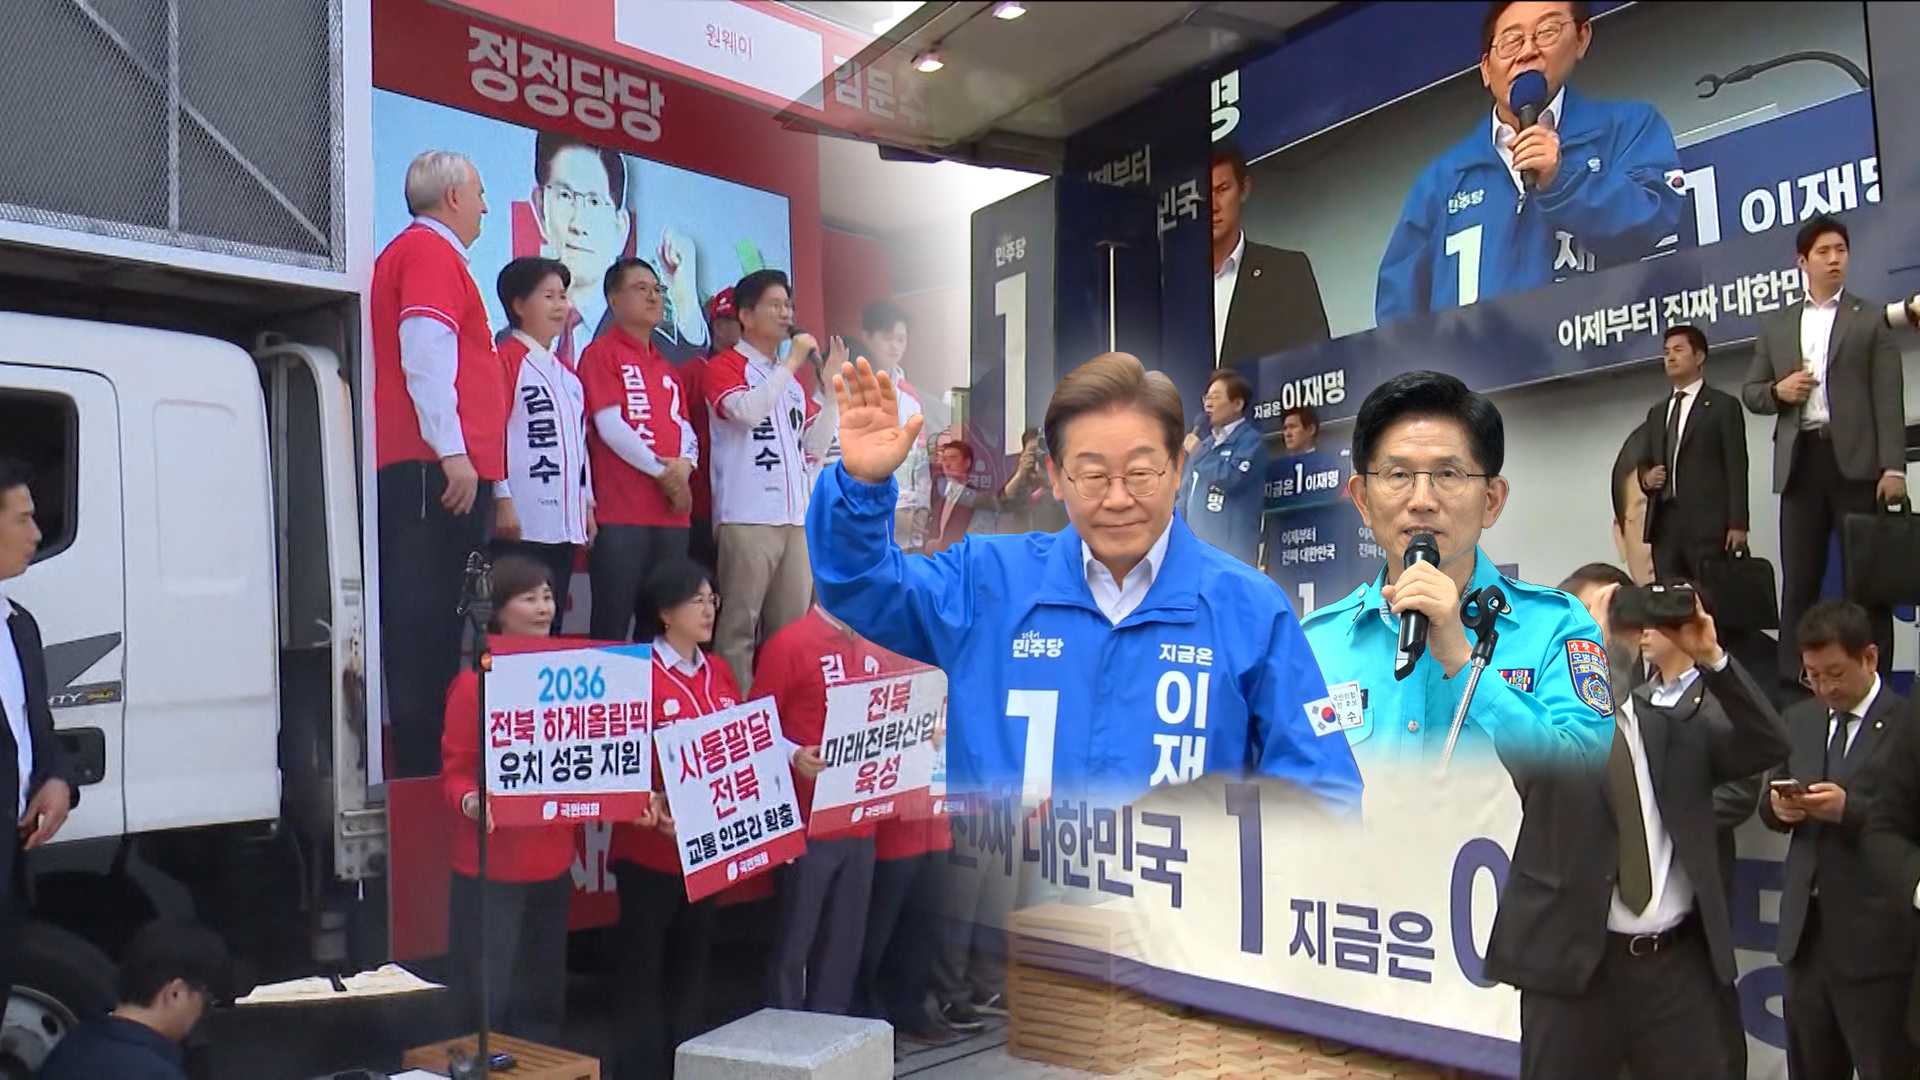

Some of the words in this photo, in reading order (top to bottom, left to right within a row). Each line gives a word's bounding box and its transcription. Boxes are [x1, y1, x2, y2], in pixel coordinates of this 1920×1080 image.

[704, 22, 752, 61] 원웨이
[467, 25, 665, 143] 정정당당
[833, 54, 928, 129] 김문수
[995, 237, 1027, 268] 민주당
[1445, 224, 1483, 307] 1
[1557, 296, 1660, 352] 이제부터
[1663, 283, 1719, 327] 진짜
[995, 271, 1027, 456] 1
[1253, 401, 1282, 421] 지금은
[1281, 368, 1346, 411] 이재명
[521, 385, 561, 484] 김문수
[1295, 463, 1303, 495] 1
[1305, 469, 1340, 492] 이재명
[1298, 582, 1315, 617] 1
[1012, 638, 1064, 658] 민주당
[1158, 643, 1214, 667] 지금은
[538, 665, 606, 703] 2036
[866, 679, 912, 722] 전북
[490, 709, 535, 748] 전북
[542, 701, 648, 742] 하계올림픽
[679, 709, 774, 784] 사통팔달
[825, 710, 938, 768] 미래전략산업
[1005, 689, 1060, 812] 1
[499, 749, 543, 790] 유치
[550, 744, 594, 782] 성공
[600, 739, 641, 776] 지원
[855, 754, 901, 794] 육성
[709, 763, 761, 820] 전북
[685, 831, 718, 866] 교통
[718, 813, 763, 852] 인프라
[1022, 798, 1188, 909] 대한민국
[1225, 784, 1263, 955] 1
[1289, 898, 1436, 984] 지금은
